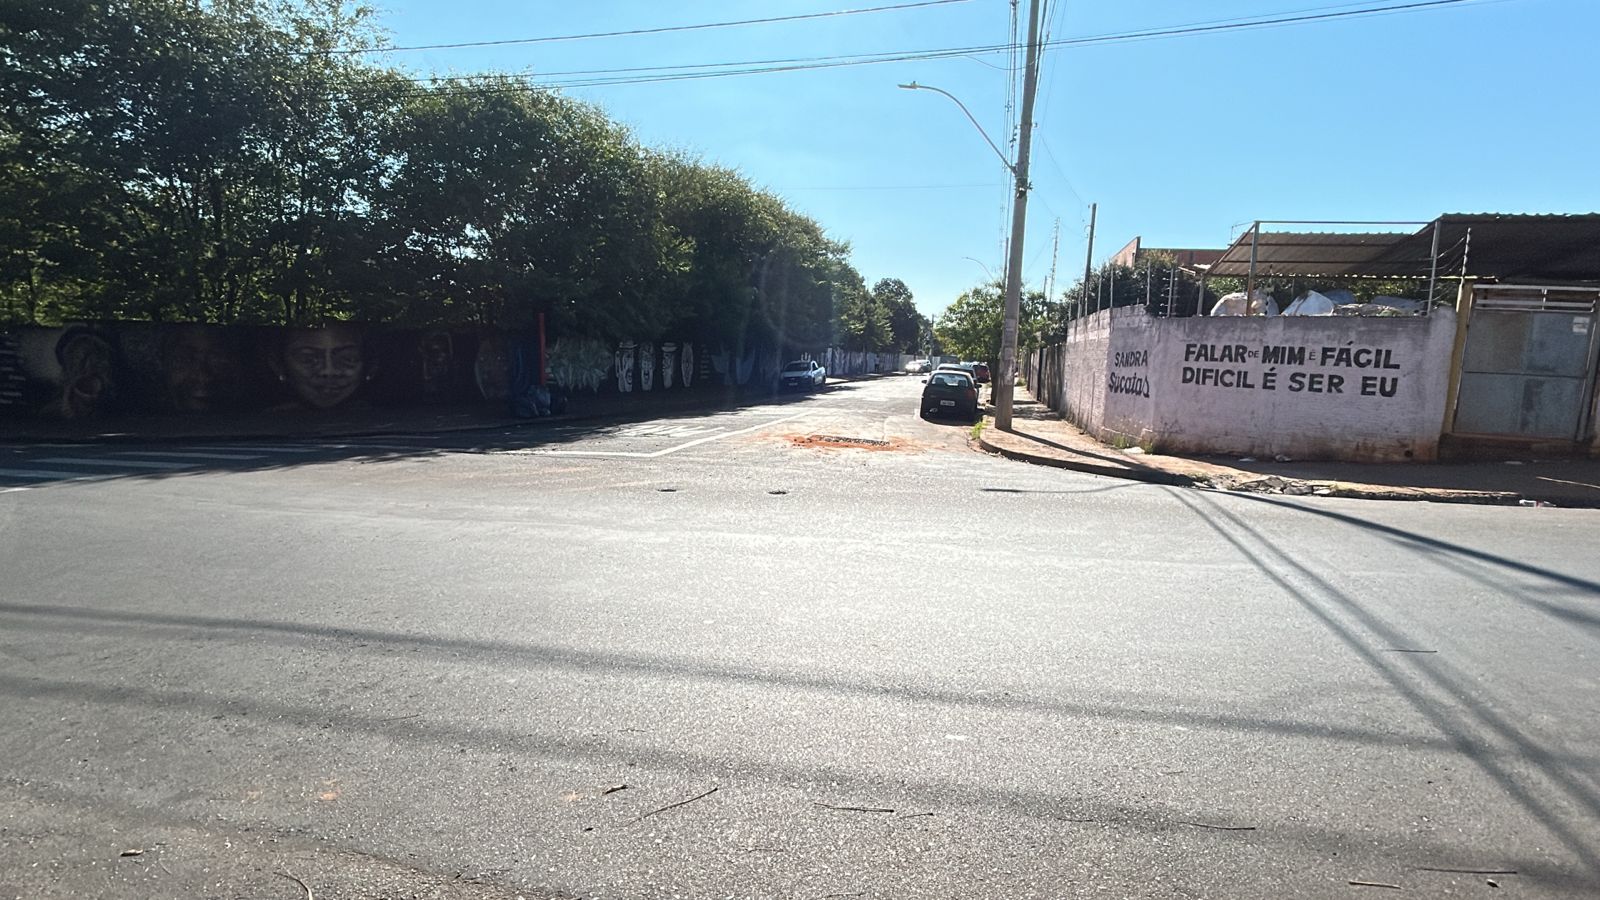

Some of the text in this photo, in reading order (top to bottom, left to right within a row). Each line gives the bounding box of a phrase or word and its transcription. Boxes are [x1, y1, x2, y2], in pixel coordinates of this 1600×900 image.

[1115, 350, 1148, 367] SANDRA
[1184, 343, 1248, 363] FALAR
[1248, 350, 1260, 358] DE
[1261, 345, 1306, 365] MIM
[1320, 340, 1400, 369] FÁCIL
[1108, 372, 1150, 398] Sucatas
[1181, 366, 1398, 397] DIFICIL É SER EU
